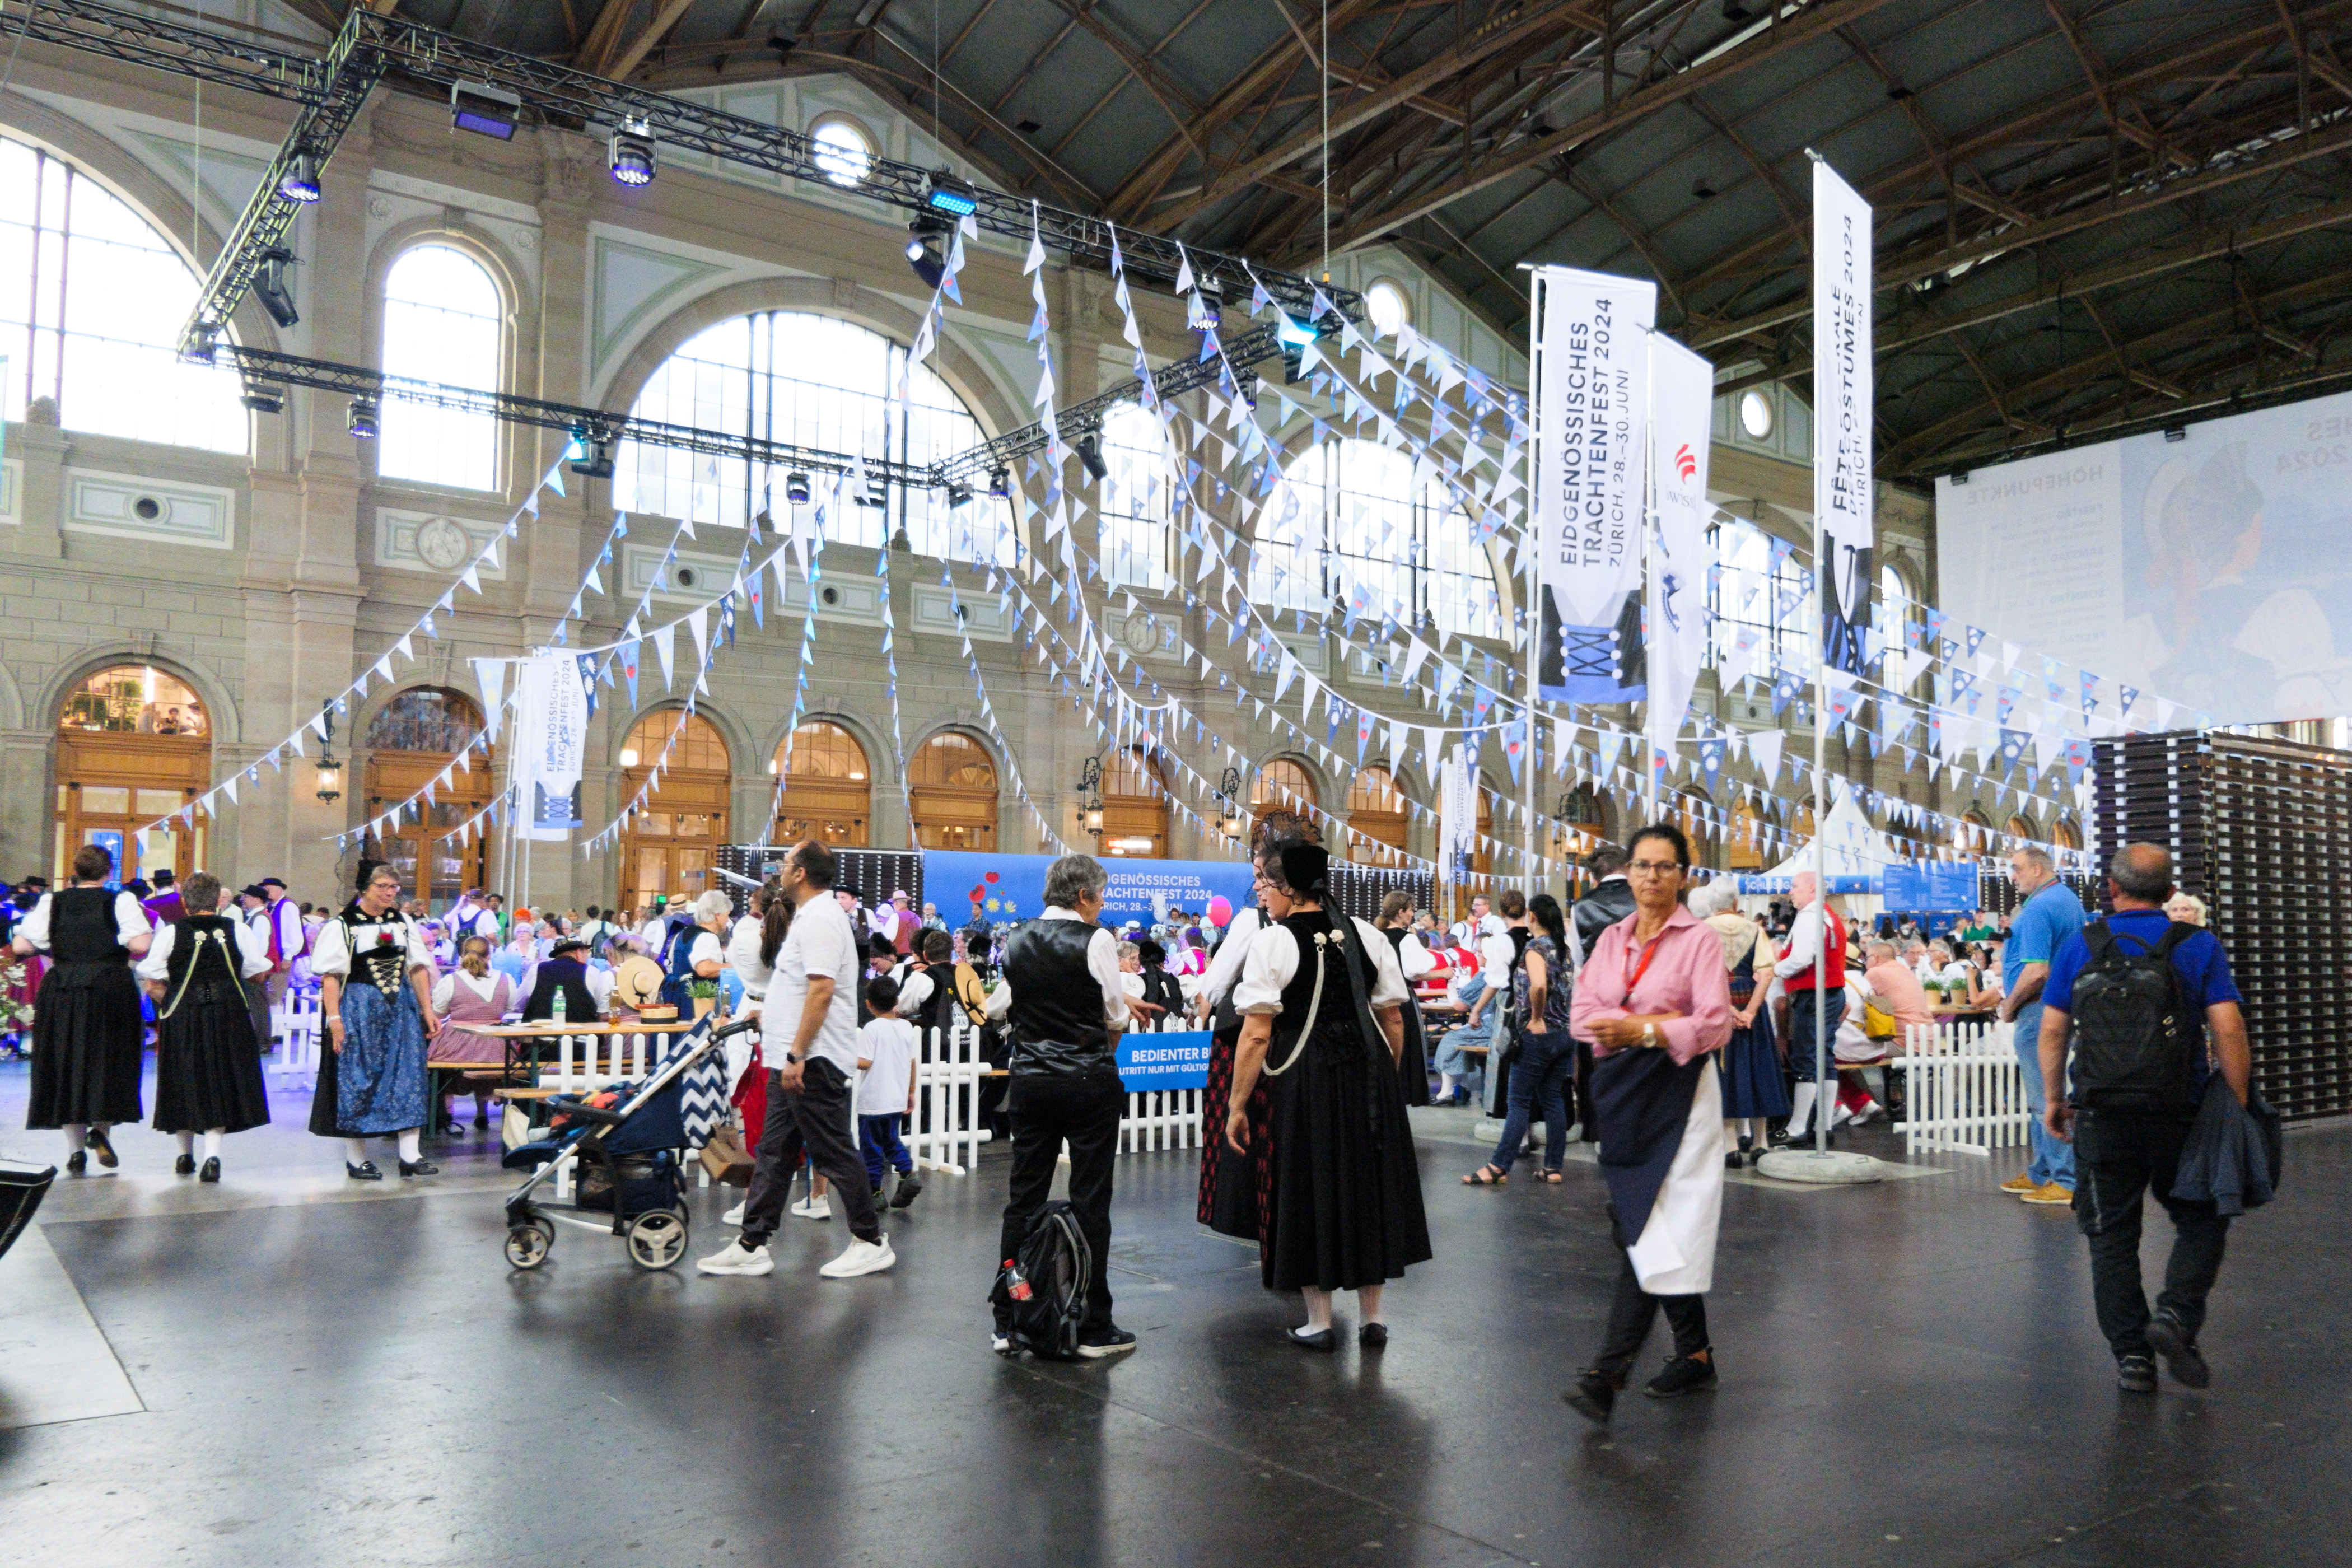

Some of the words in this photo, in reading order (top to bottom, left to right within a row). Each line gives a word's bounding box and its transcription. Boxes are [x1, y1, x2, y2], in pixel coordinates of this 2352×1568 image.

[1844, 215, 1852, 284] 2024
[1593, 298, 1613, 360] 2024
[1560, 321, 1589, 566] EIDGENÖSSISCHES
[1583, 366, 1609, 568] TRACHTENFEST
[1608, 489, 1625, 568] ZÜRICH,
[561, 659, 571, 686] 2024
[1107, 872, 1200, 886] GENÖSSISCHES
[1101, 887, 1182, 899] ACHTENEST
[1184, 889, 1212, 900] 2024
[1103, 902, 1128, 912] RICH,
[1164, 903, 1182, 912] UNI
[1132, 1048, 1200, 1063] BEDIENTER
[1118, 1066, 1146, 1076] UTRITT
[1147, 1065, 1165, 1074] NUR
[1165, 1065, 1180, 1074] MIT
